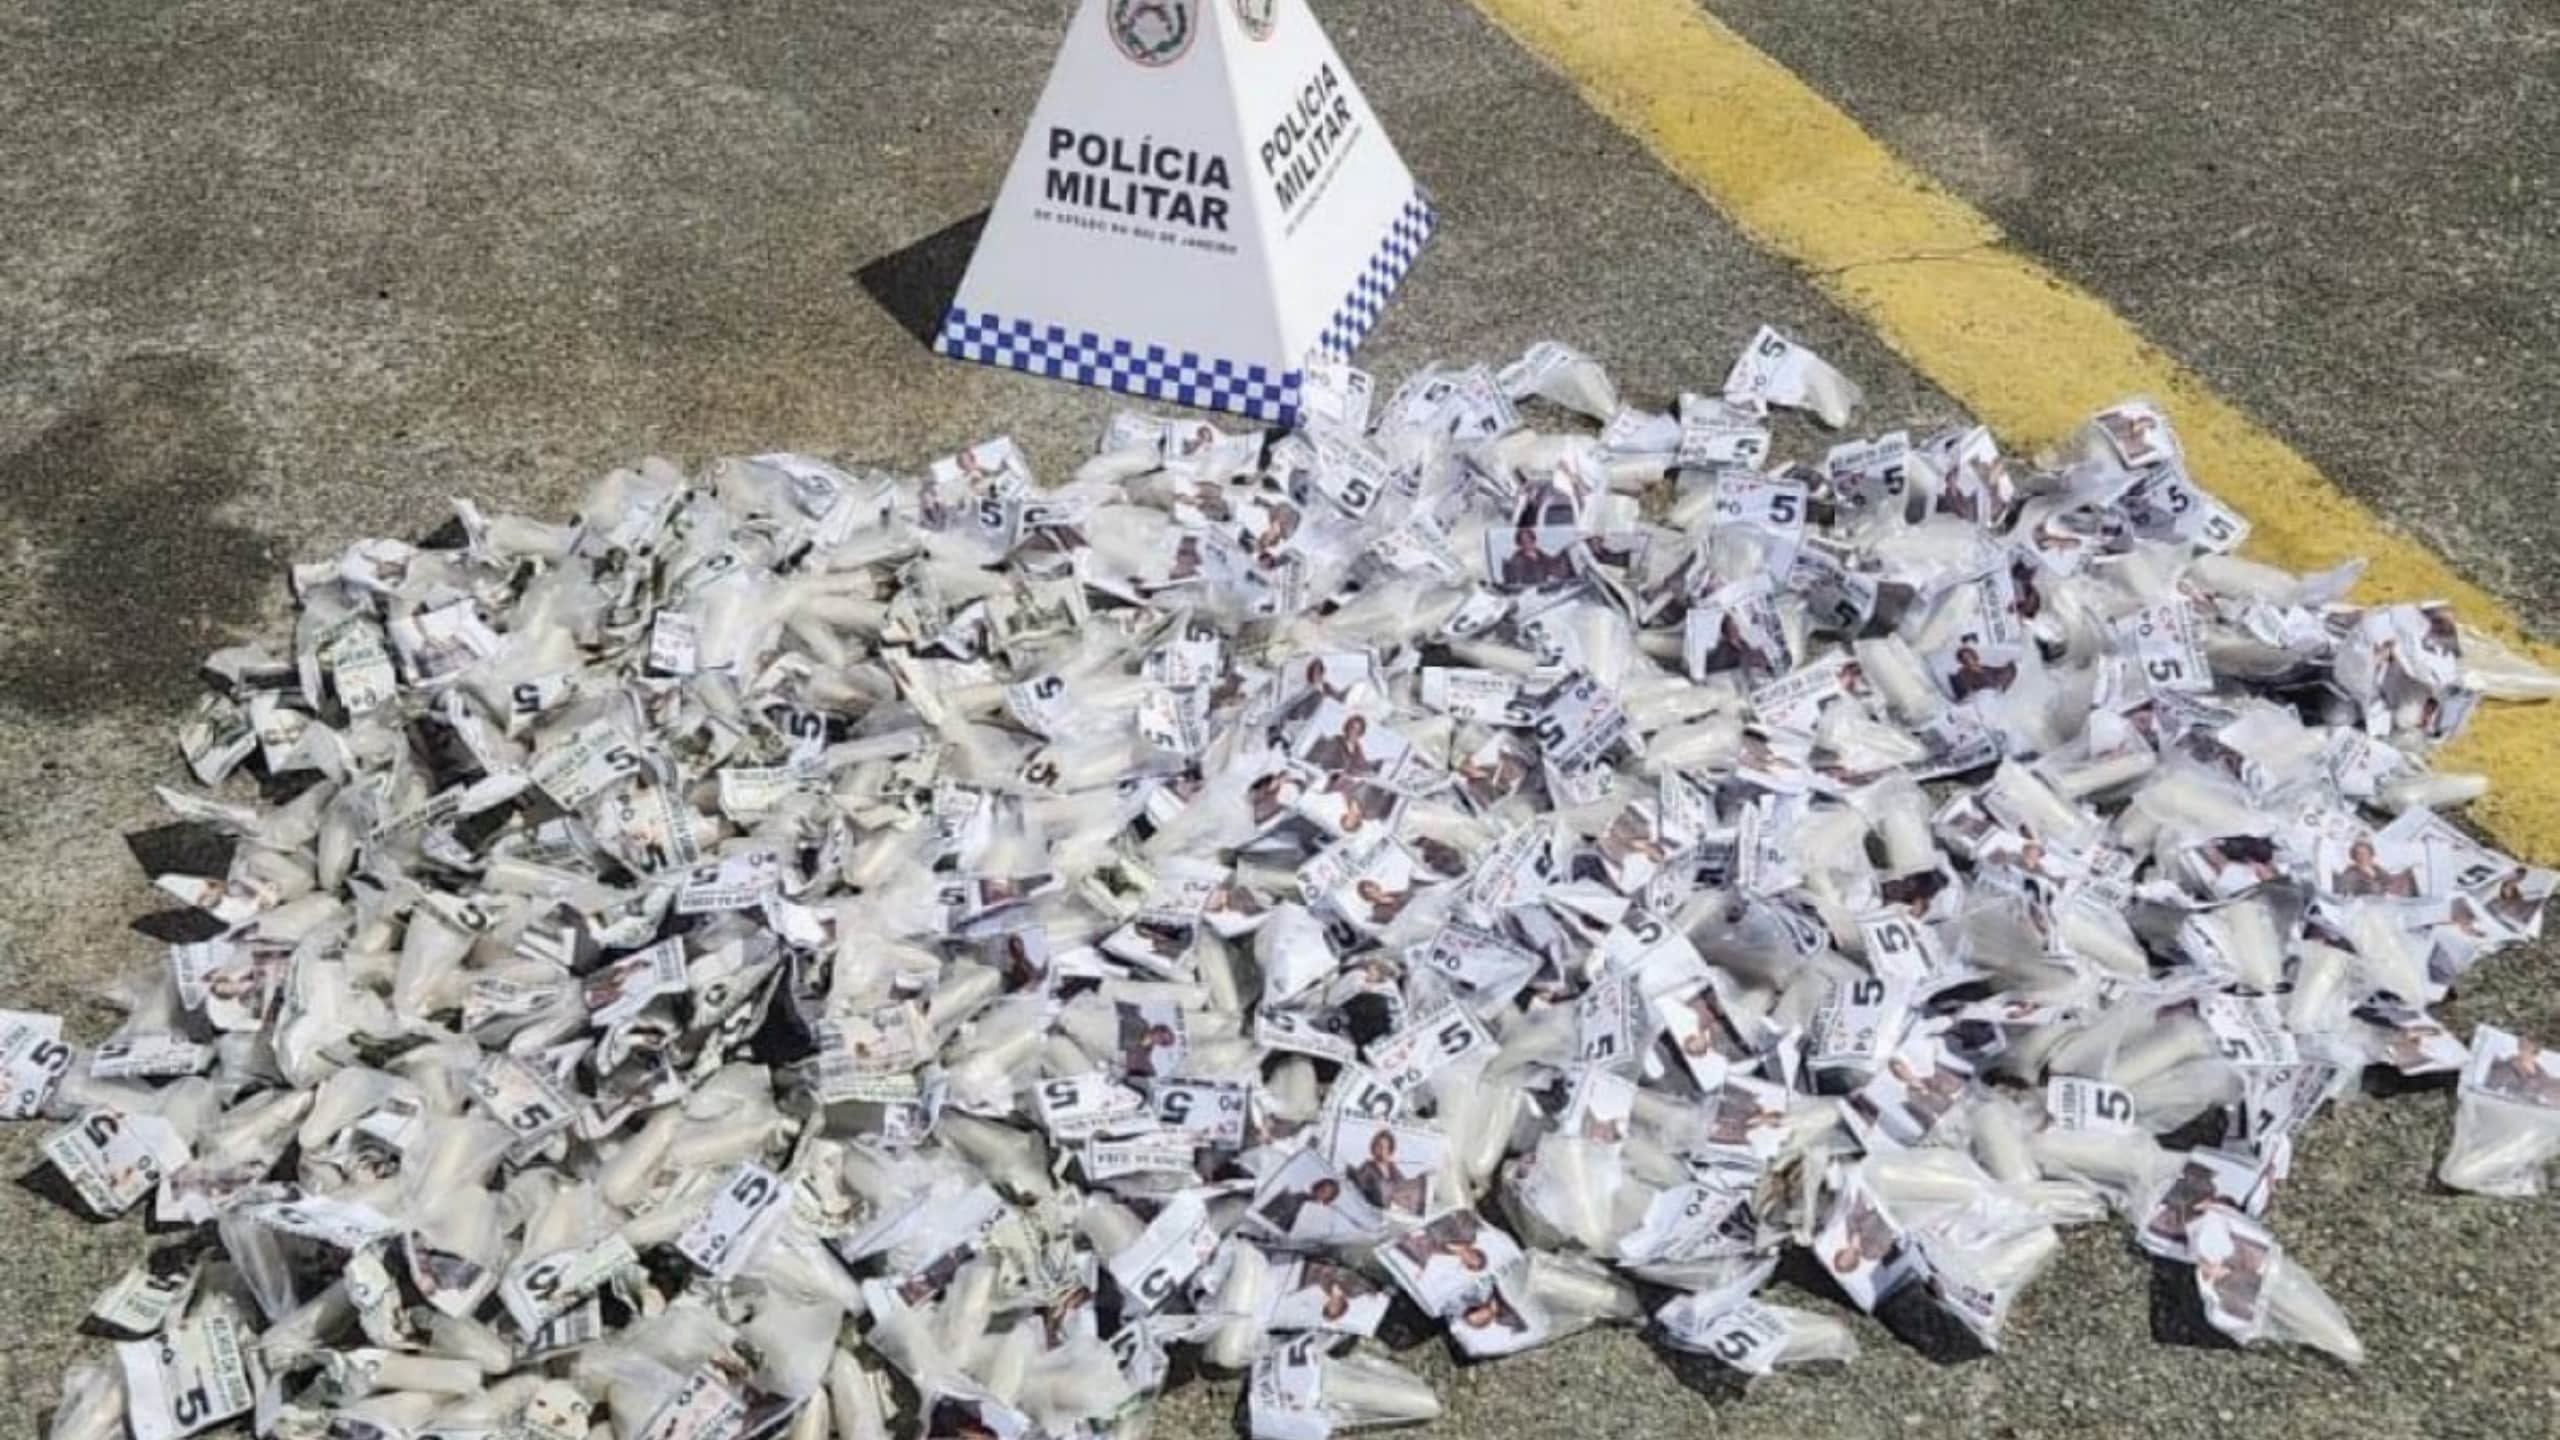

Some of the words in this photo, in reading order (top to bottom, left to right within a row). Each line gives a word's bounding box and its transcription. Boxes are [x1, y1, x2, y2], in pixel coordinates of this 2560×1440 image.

[1049, 127, 1231, 190] POLÍCIA
[1274, 95, 1352, 213] MILITAR
[1046, 169, 1229, 232] MILITAR
[1759, 334, 1786, 357] 5
[1341, 478, 1372, 508] 5
[1884, 465, 1904, 495] 5
[1769, 495, 1797, 523] 5
[2169, 485, 2189, 513] 5
[980, 502, 1002, 527] 5
[2204, 515, 2236, 542] 5
[2149, 658, 2184, 682] 5
[512, 683, 541, 713] 5
[1034, 676, 1064, 699] 5
[789, 712, 823, 741] 5
[1536, 716, 1566, 749] 5
[604, 745, 638, 771] 5
[1877, 923, 1909, 954] 5
[1853, 977, 1884, 1006] 5
[1438, 1020, 1472, 1055] 5
[29, 1039, 70, 1072] 5
[1045, 1080, 1078, 1110] 5
[1159, 1090, 1194, 1126] 5
[1358, 1084, 1395, 1119] 5
[2095, 1087, 2132, 1122] 5
[84, 1113, 119, 1149] 5
[512, 1103, 551, 1132] 5
[731, 1176, 769, 1209] 5
[1716, 1329, 1758, 1360] 5
[176, 1387, 212, 1427] 5
